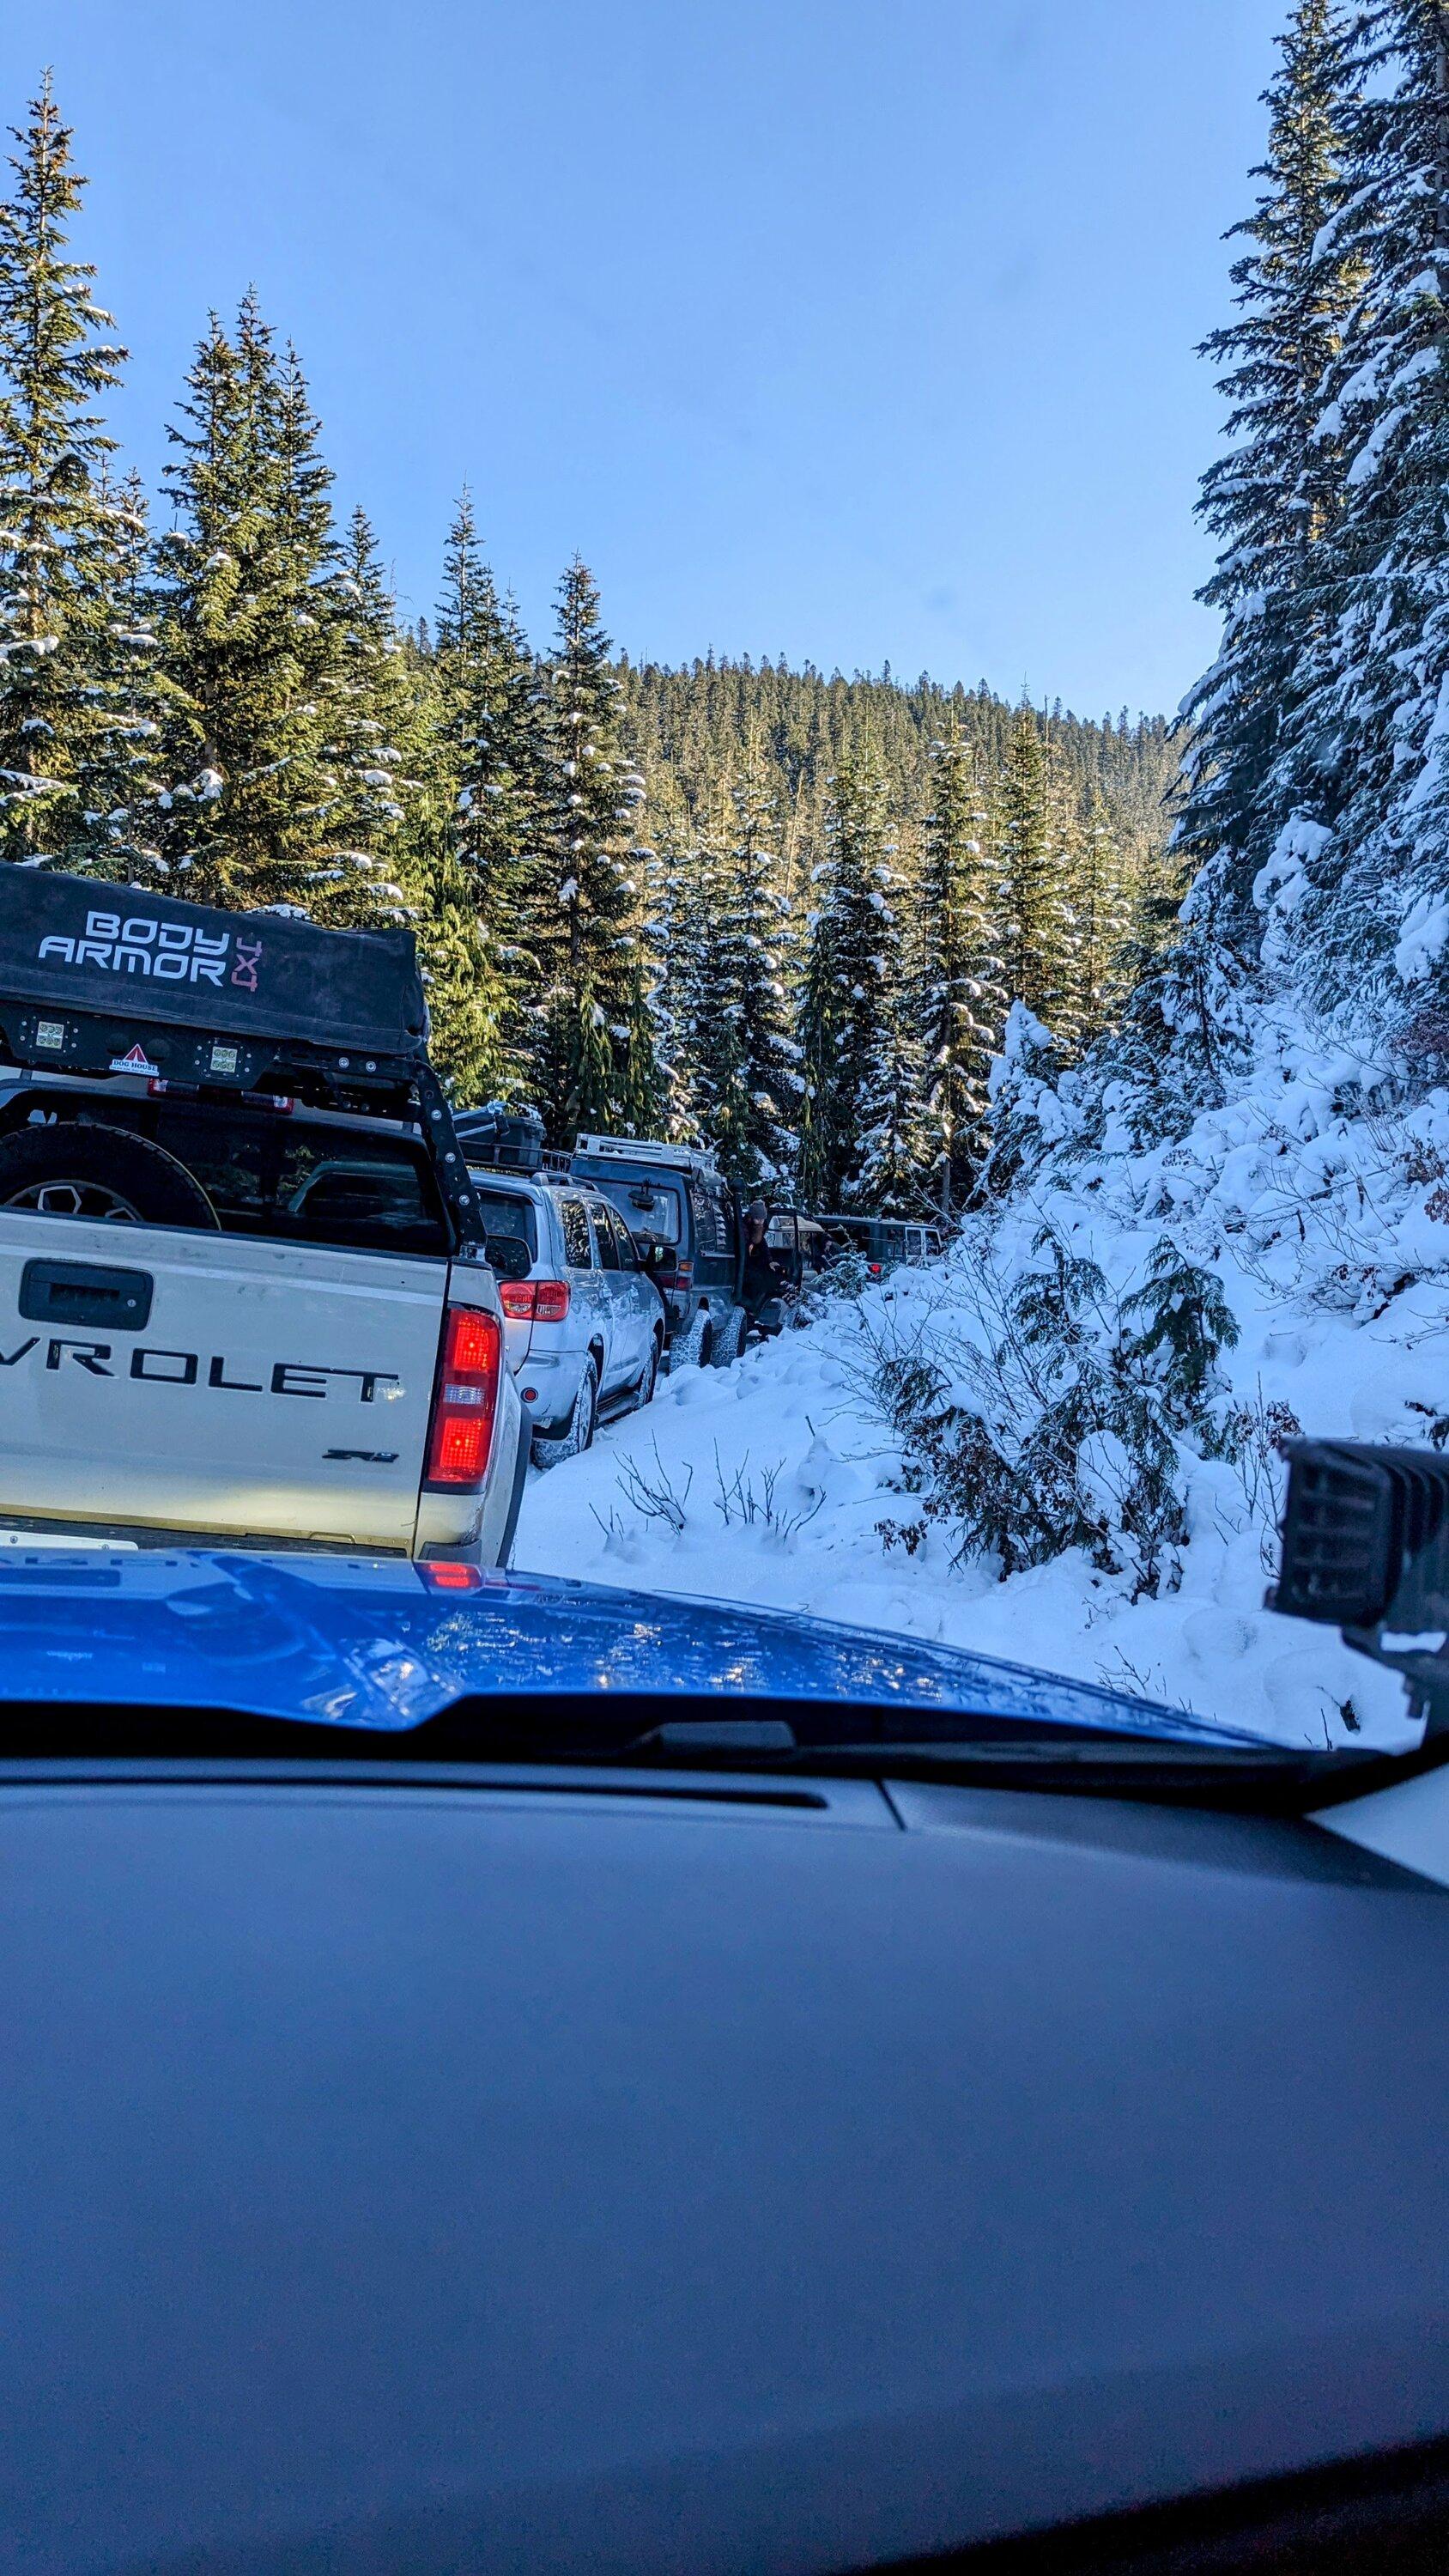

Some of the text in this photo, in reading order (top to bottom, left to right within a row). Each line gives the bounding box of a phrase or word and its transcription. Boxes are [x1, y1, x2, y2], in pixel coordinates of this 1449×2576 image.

[86, 910, 230, 956] BODY
[38, 935, 227, 987] ARMOR
[131, 1062, 156, 1072] HOUSE
